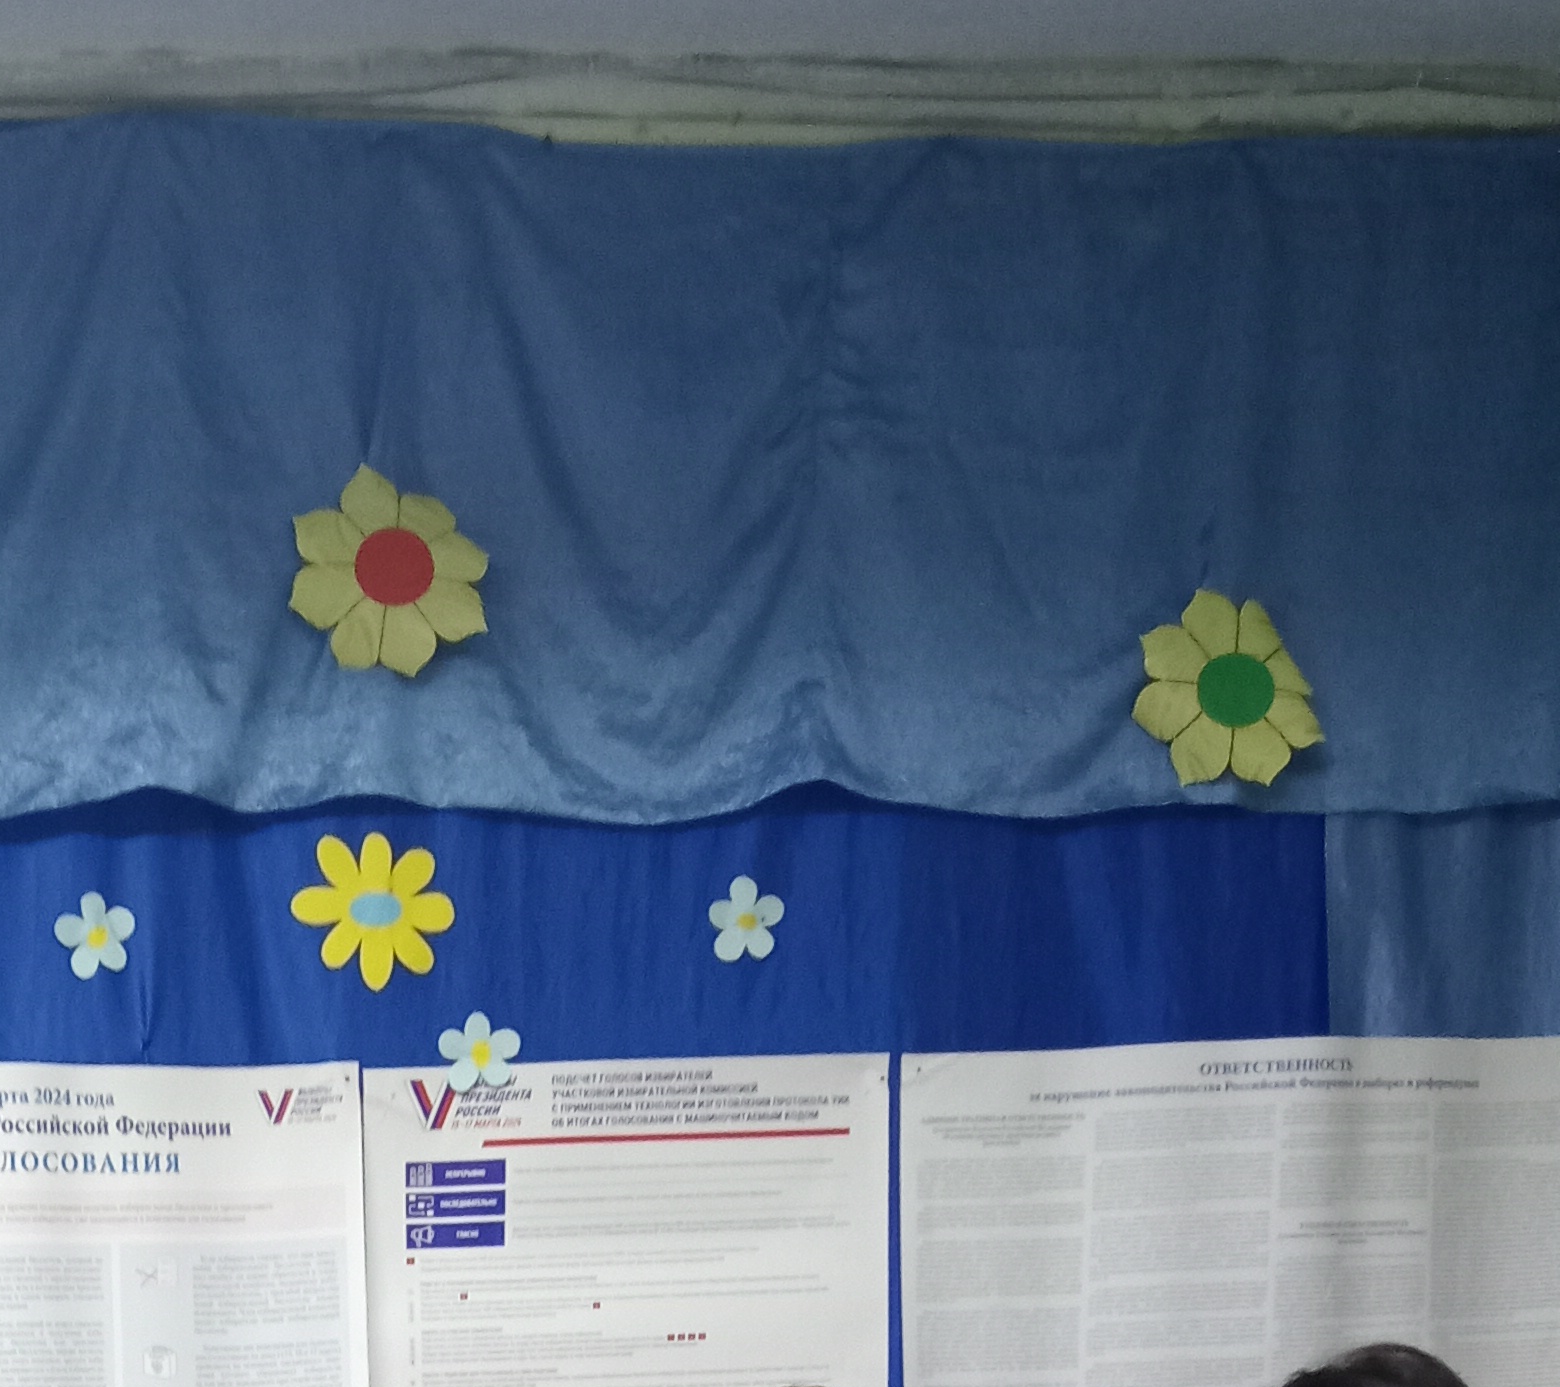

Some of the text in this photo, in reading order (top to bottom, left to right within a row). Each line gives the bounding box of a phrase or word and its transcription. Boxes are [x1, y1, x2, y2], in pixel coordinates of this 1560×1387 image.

[1200, 1058, 1353, 1076] ОТВЕТСТВЕННОСТЬ
[34, 1086, 71, 1106] 2024
[75, 1090, 115, 1109] года
[461, 1088, 532, 1104] ПРЕЗИДЕНТА
[455, 1104, 501, 1117] РОССИИ
[115, 1114, 232, 1141] Федерации
